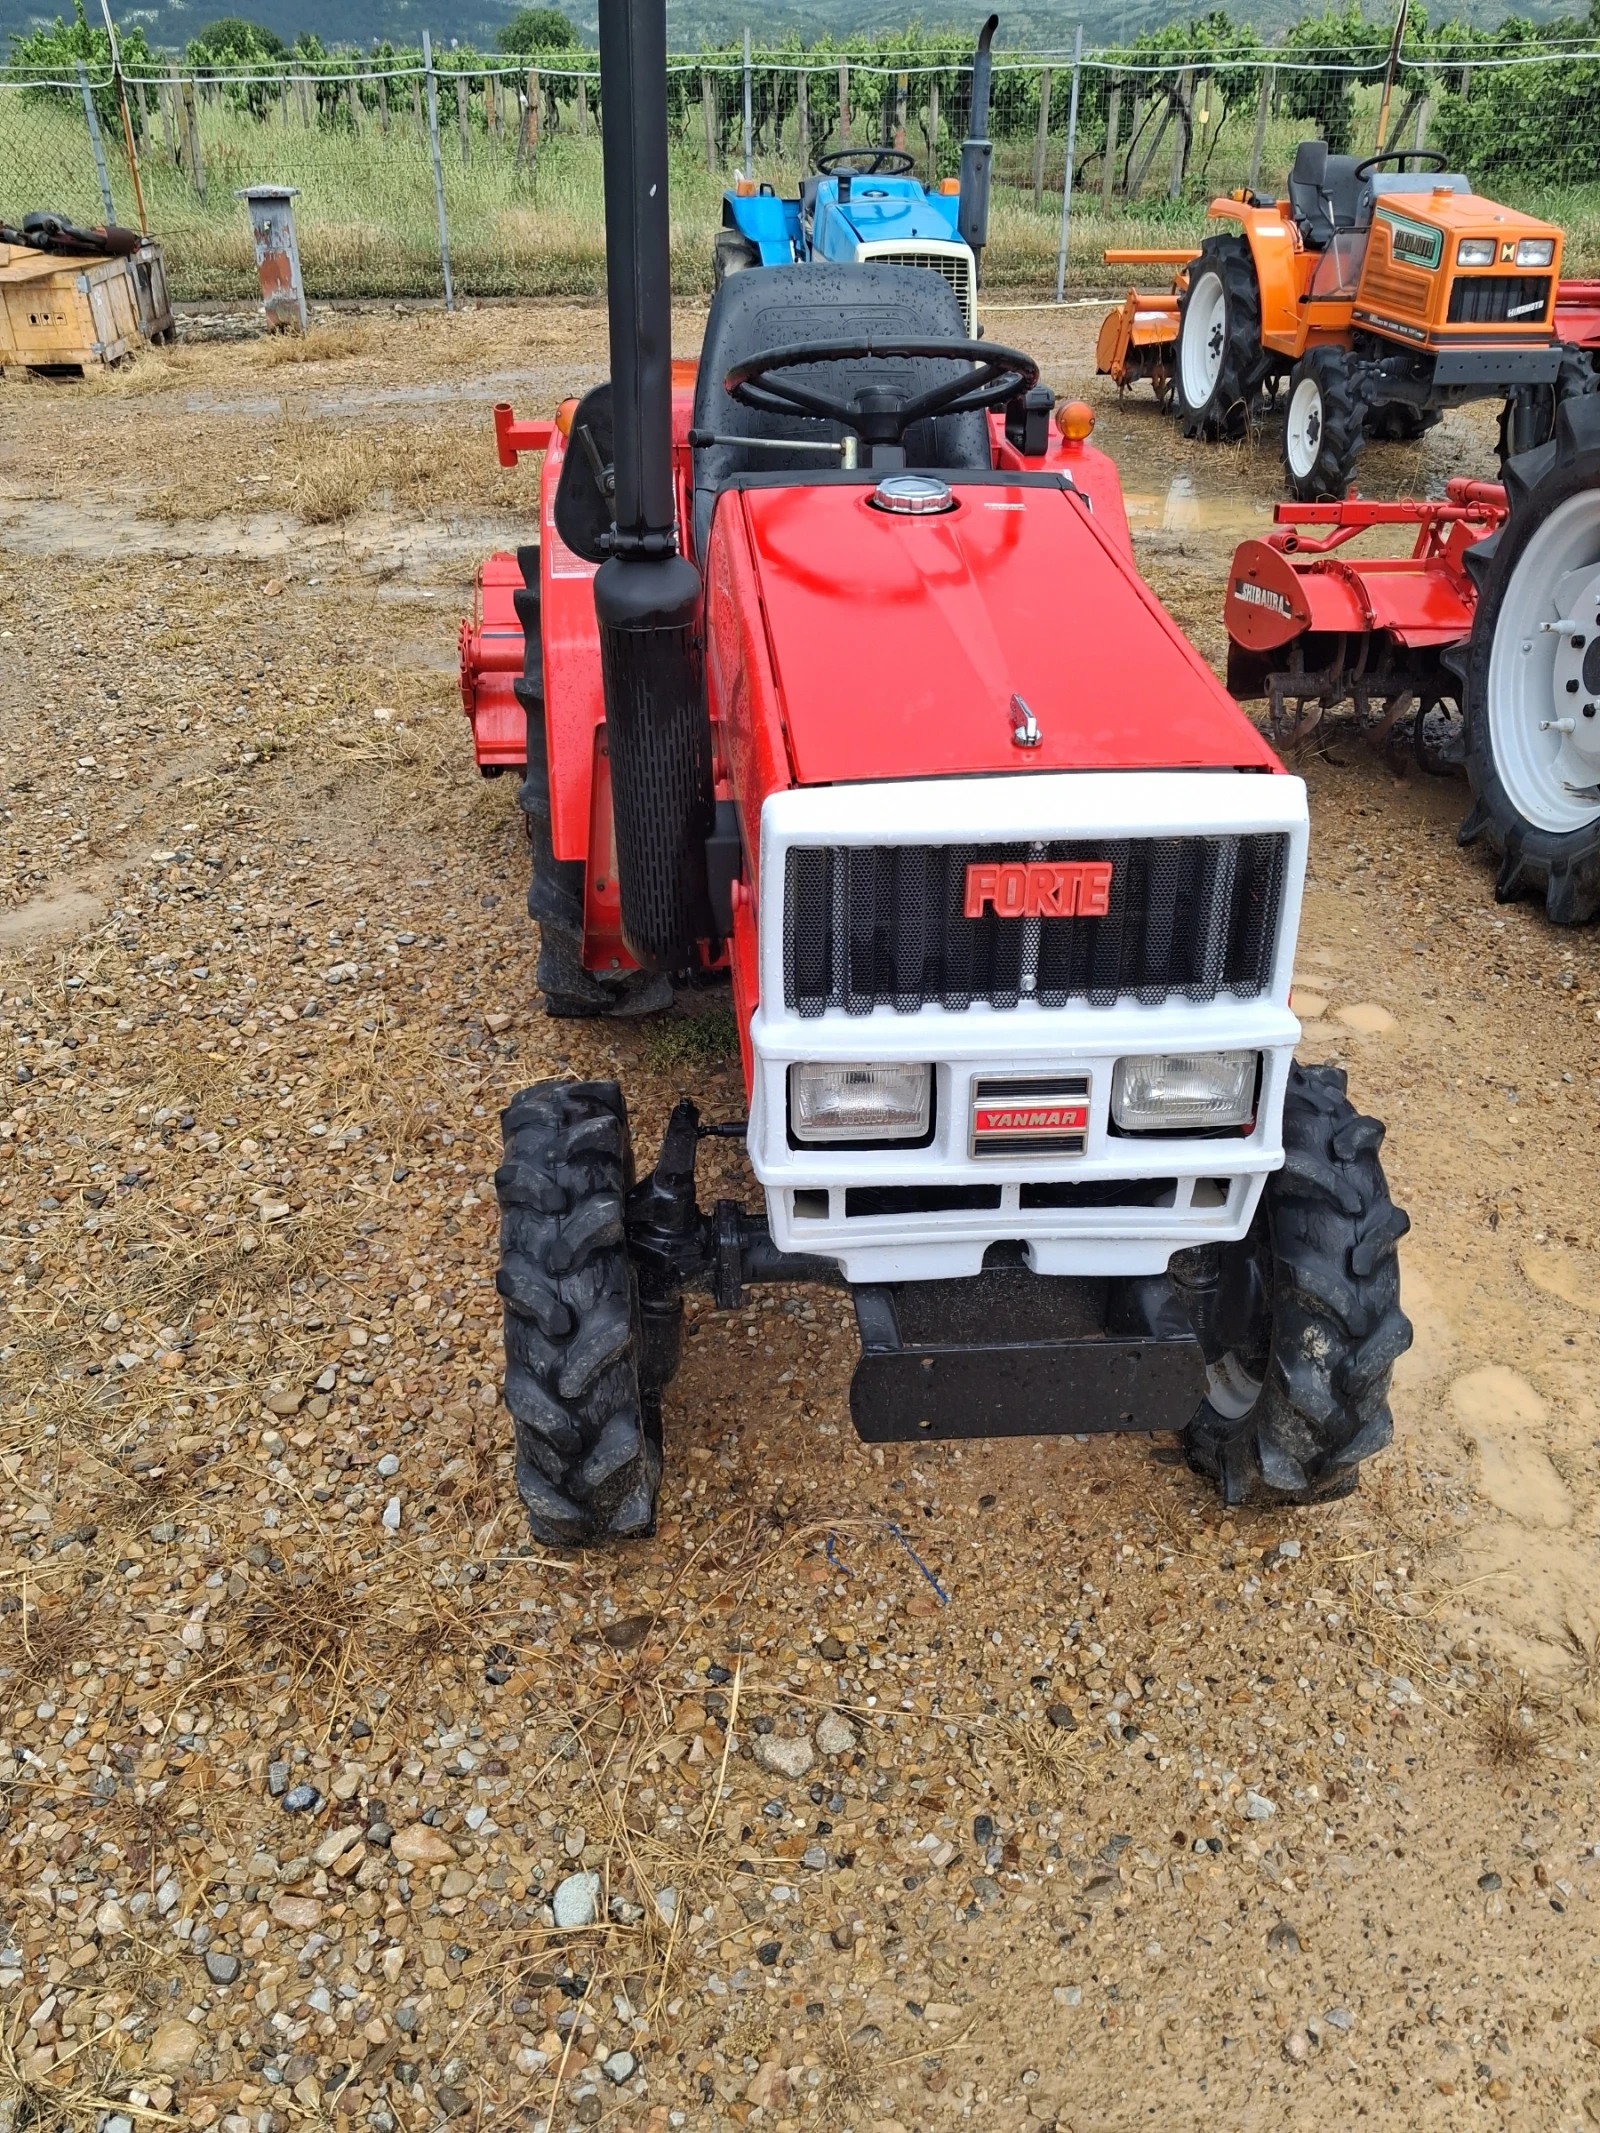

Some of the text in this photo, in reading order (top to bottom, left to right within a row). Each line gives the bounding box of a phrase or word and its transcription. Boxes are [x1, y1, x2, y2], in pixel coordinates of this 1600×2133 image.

[1242, 583, 1284, 614] SHIBAURA
[964, 862, 1113, 918] FORTE
[986, 1112, 1077, 1127] YANMAR
